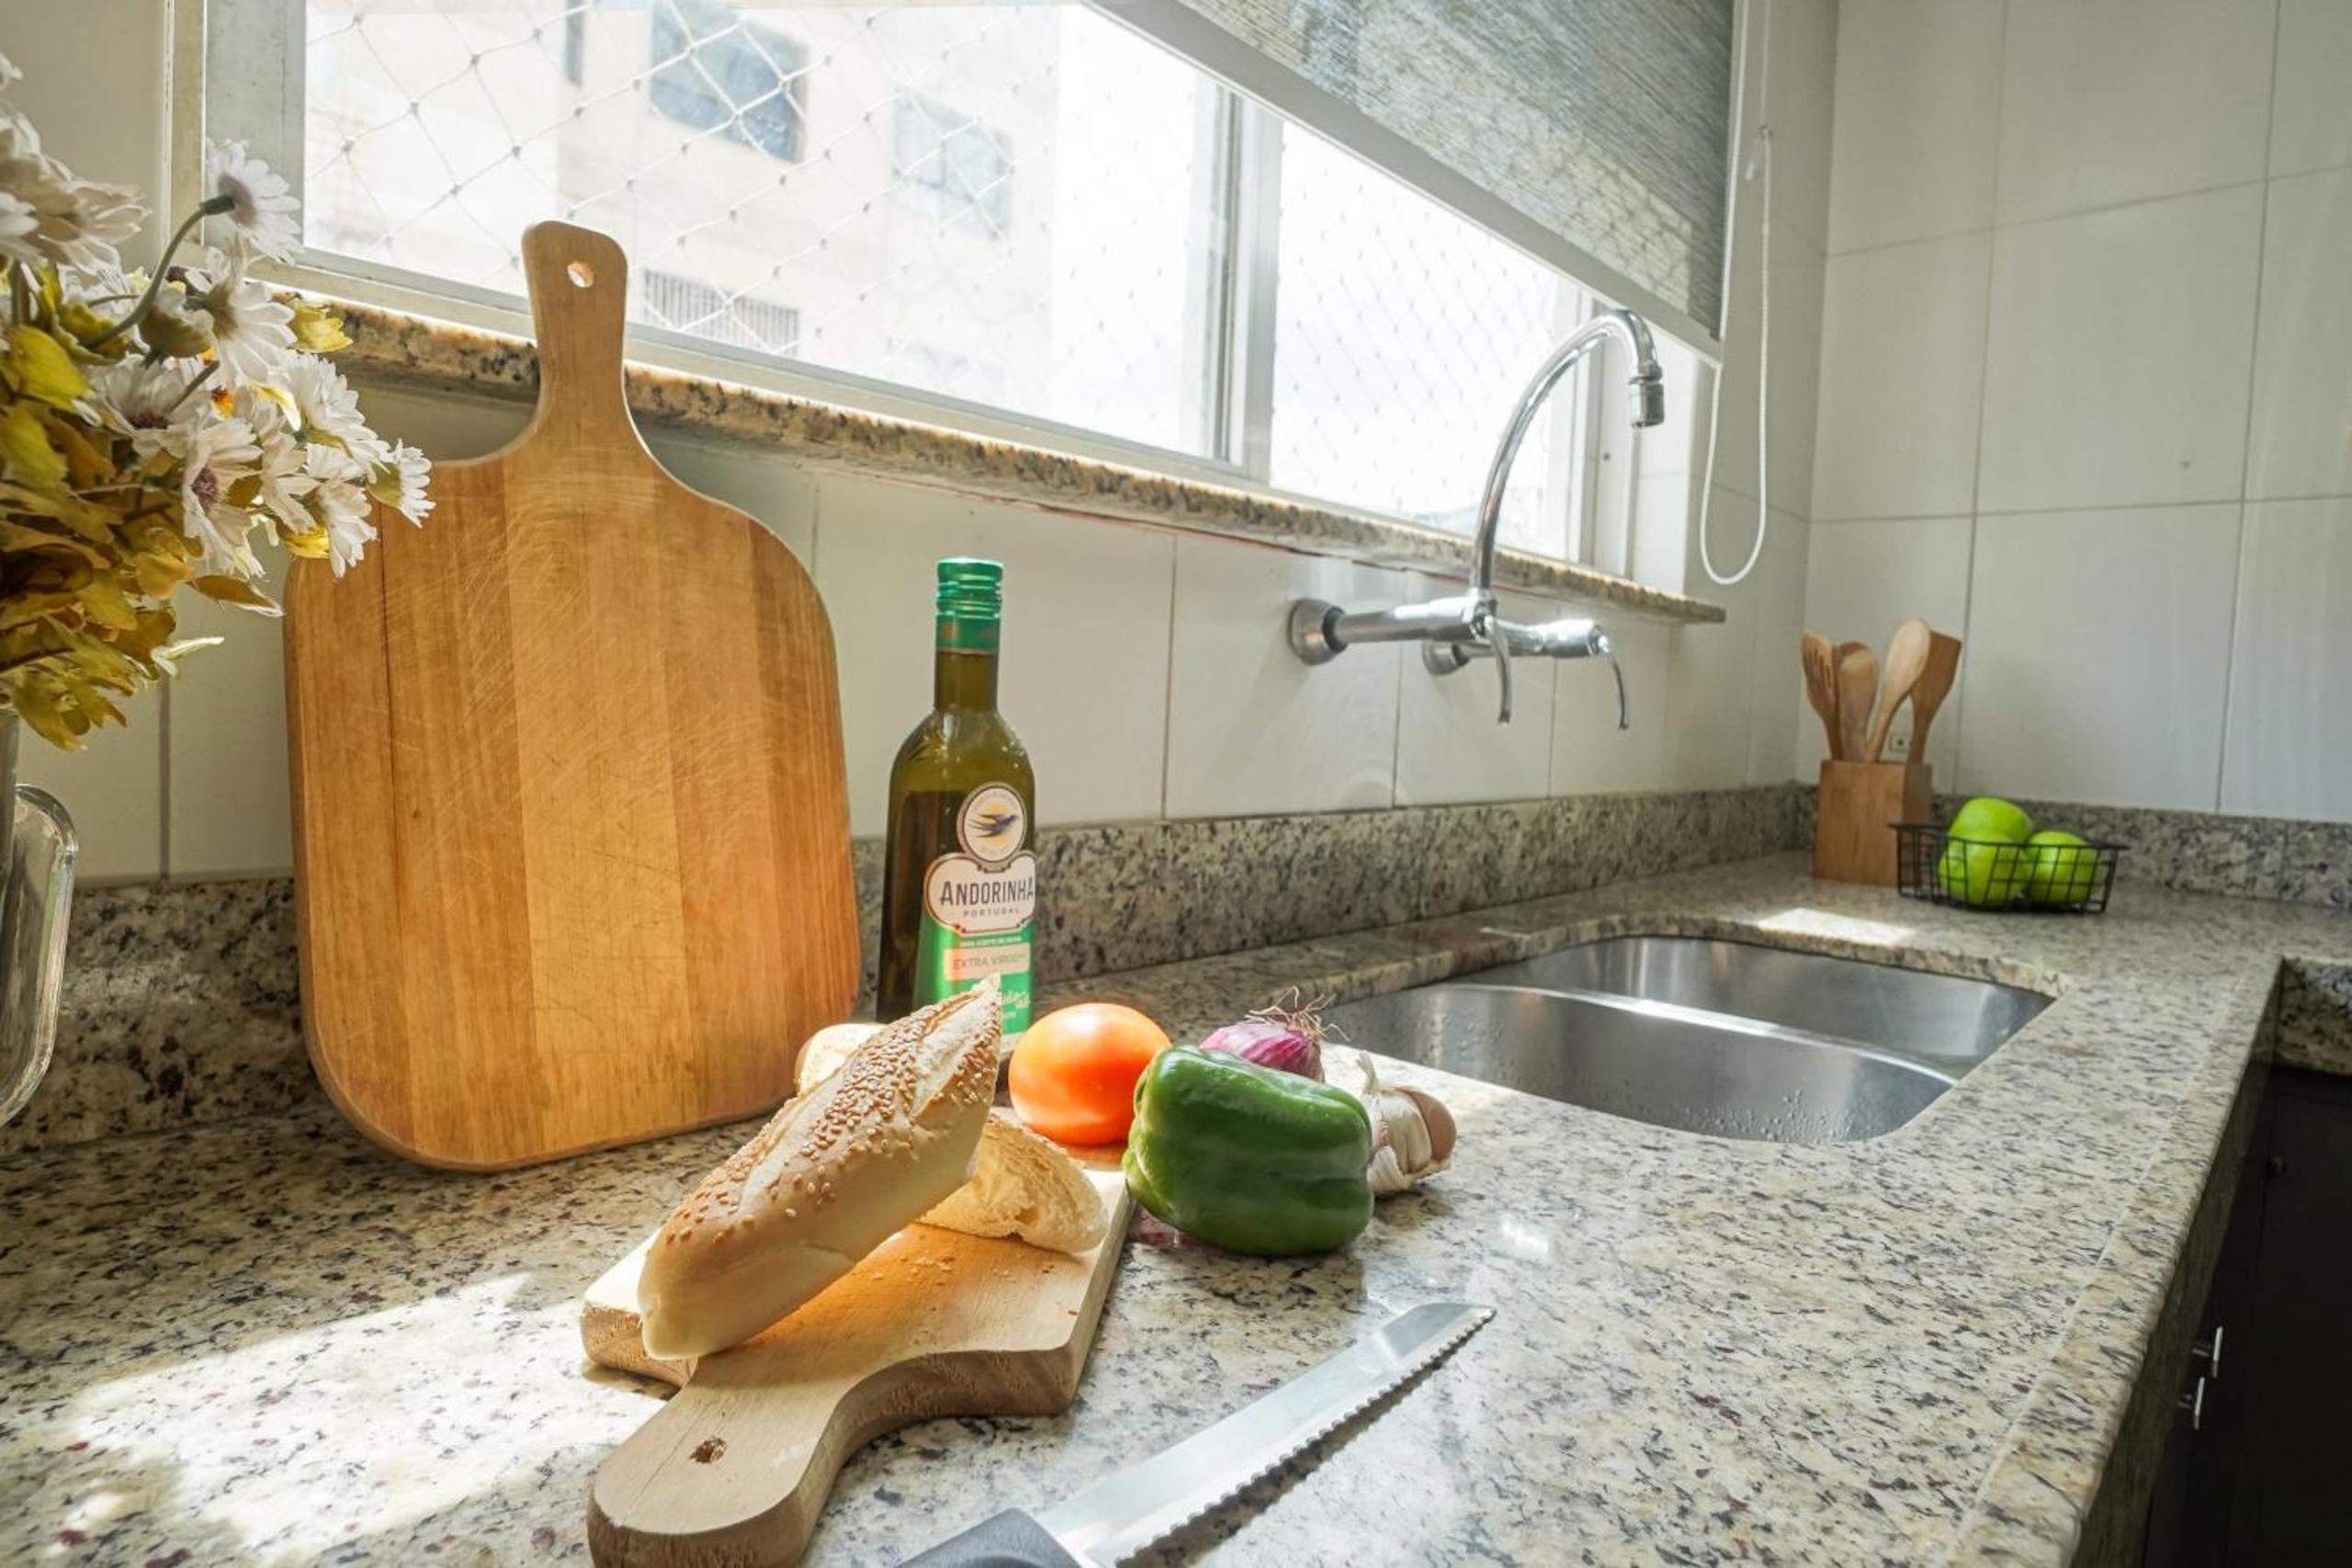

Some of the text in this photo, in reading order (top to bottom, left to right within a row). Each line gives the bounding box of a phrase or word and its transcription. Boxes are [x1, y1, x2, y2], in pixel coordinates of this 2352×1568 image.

[940, 875, 1034, 906] ANDORINHA
[963, 906, 1020, 918] PORTUGAL
[953, 956, 988, 969] EXTRA
